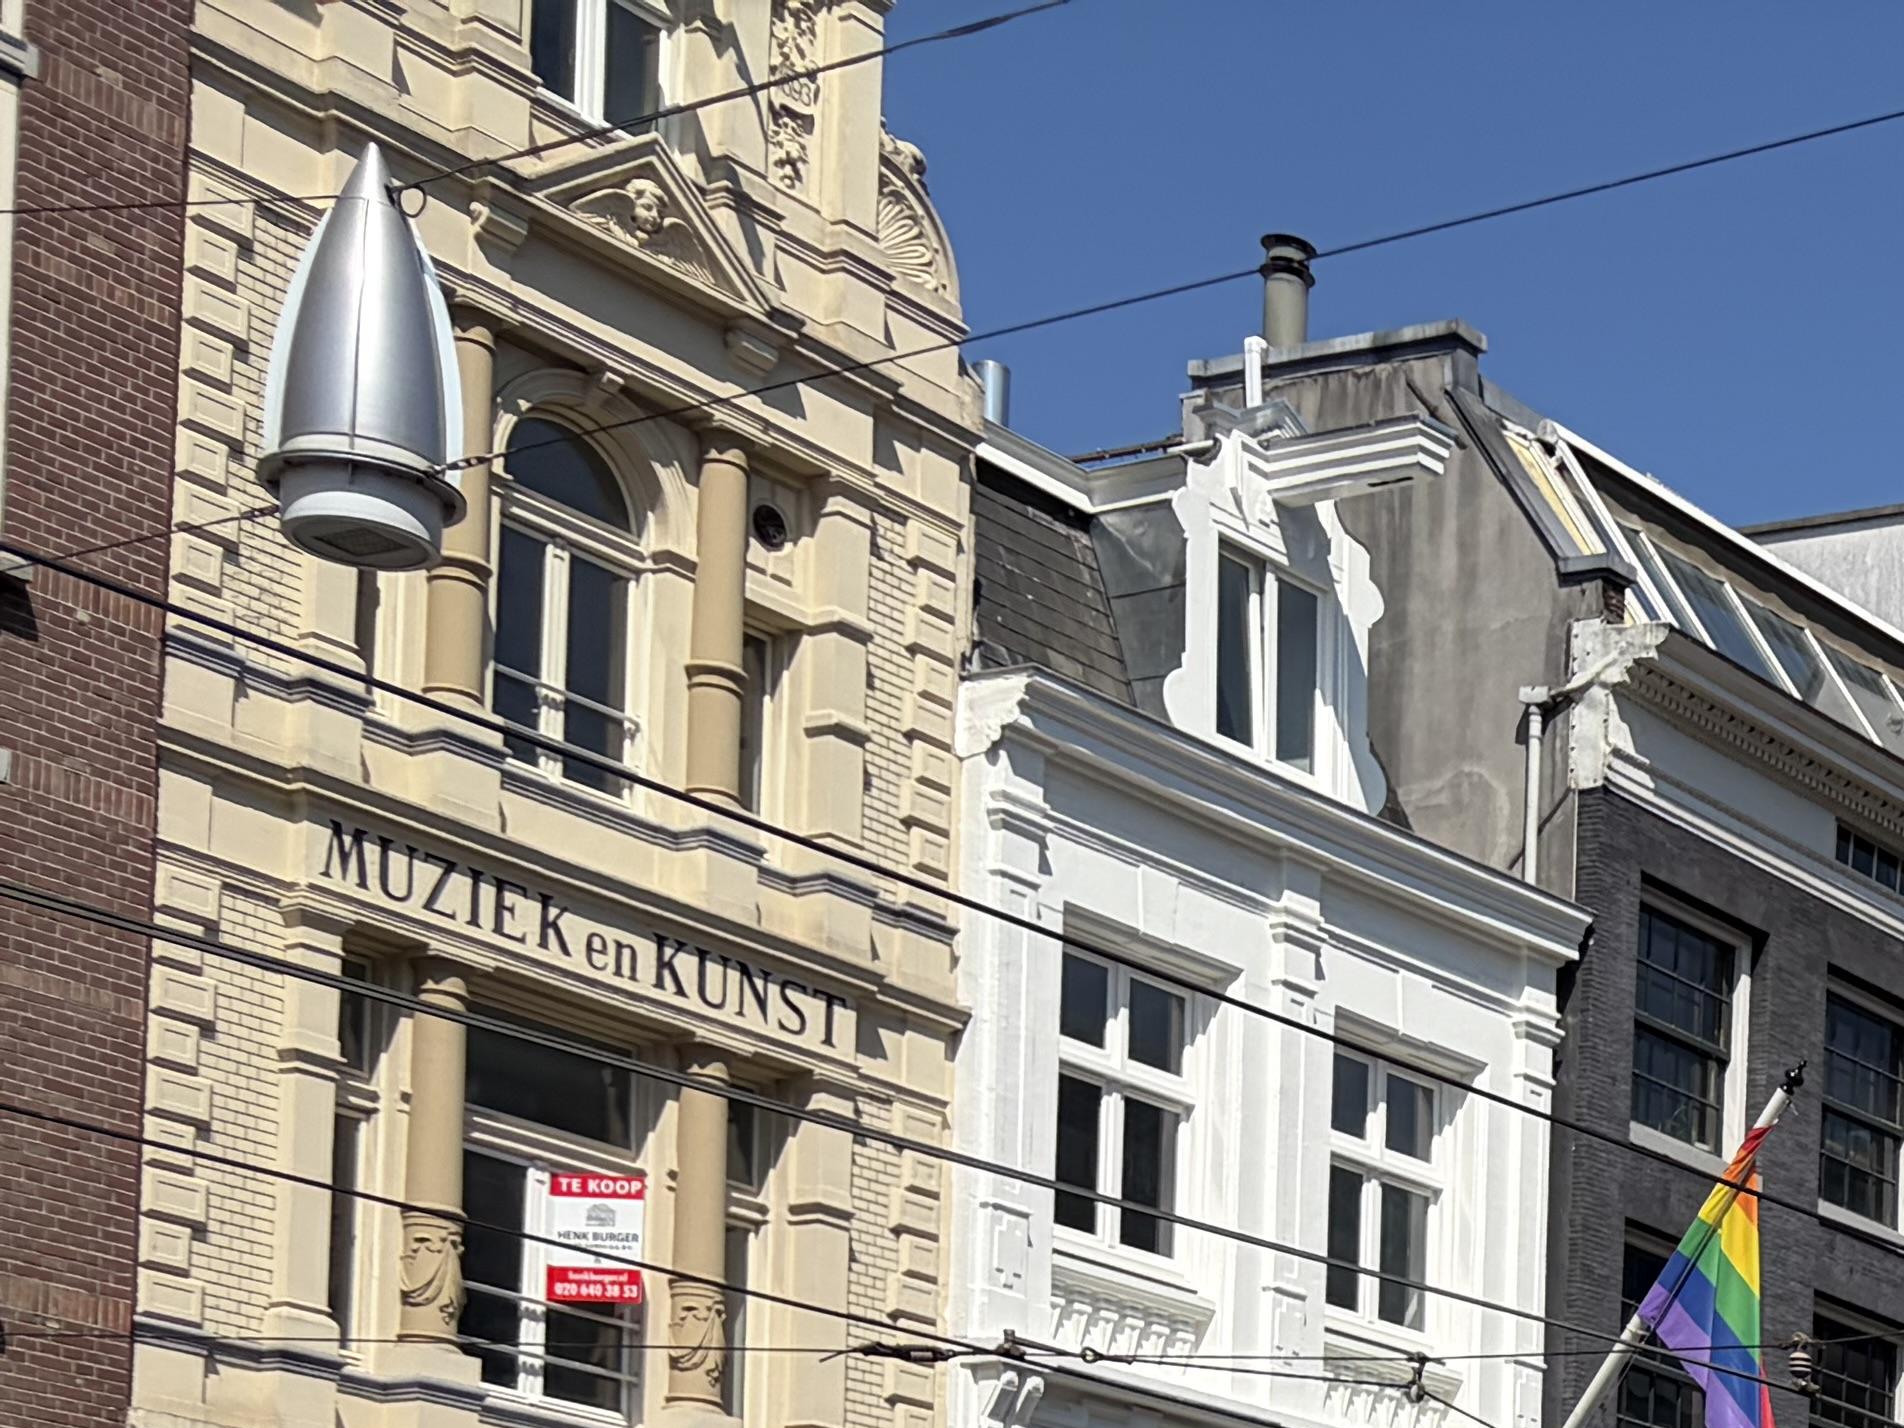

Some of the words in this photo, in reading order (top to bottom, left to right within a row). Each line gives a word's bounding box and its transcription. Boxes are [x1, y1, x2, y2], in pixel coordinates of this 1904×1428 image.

[318, 818, 572, 958] MUZIEK
[585, 930, 639, 983] en
[651, 931, 849, 1049] KUNST
[558, 1177, 582, 1193] TE
[587, 1178, 642, 1195] KOOP
[557, 1230, 590, 1242] HENK
[591, 1231, 640, 1243] BURGER
[554, 1283, 578, 1296] 020
[622, 1285, 638, 1298] 53
